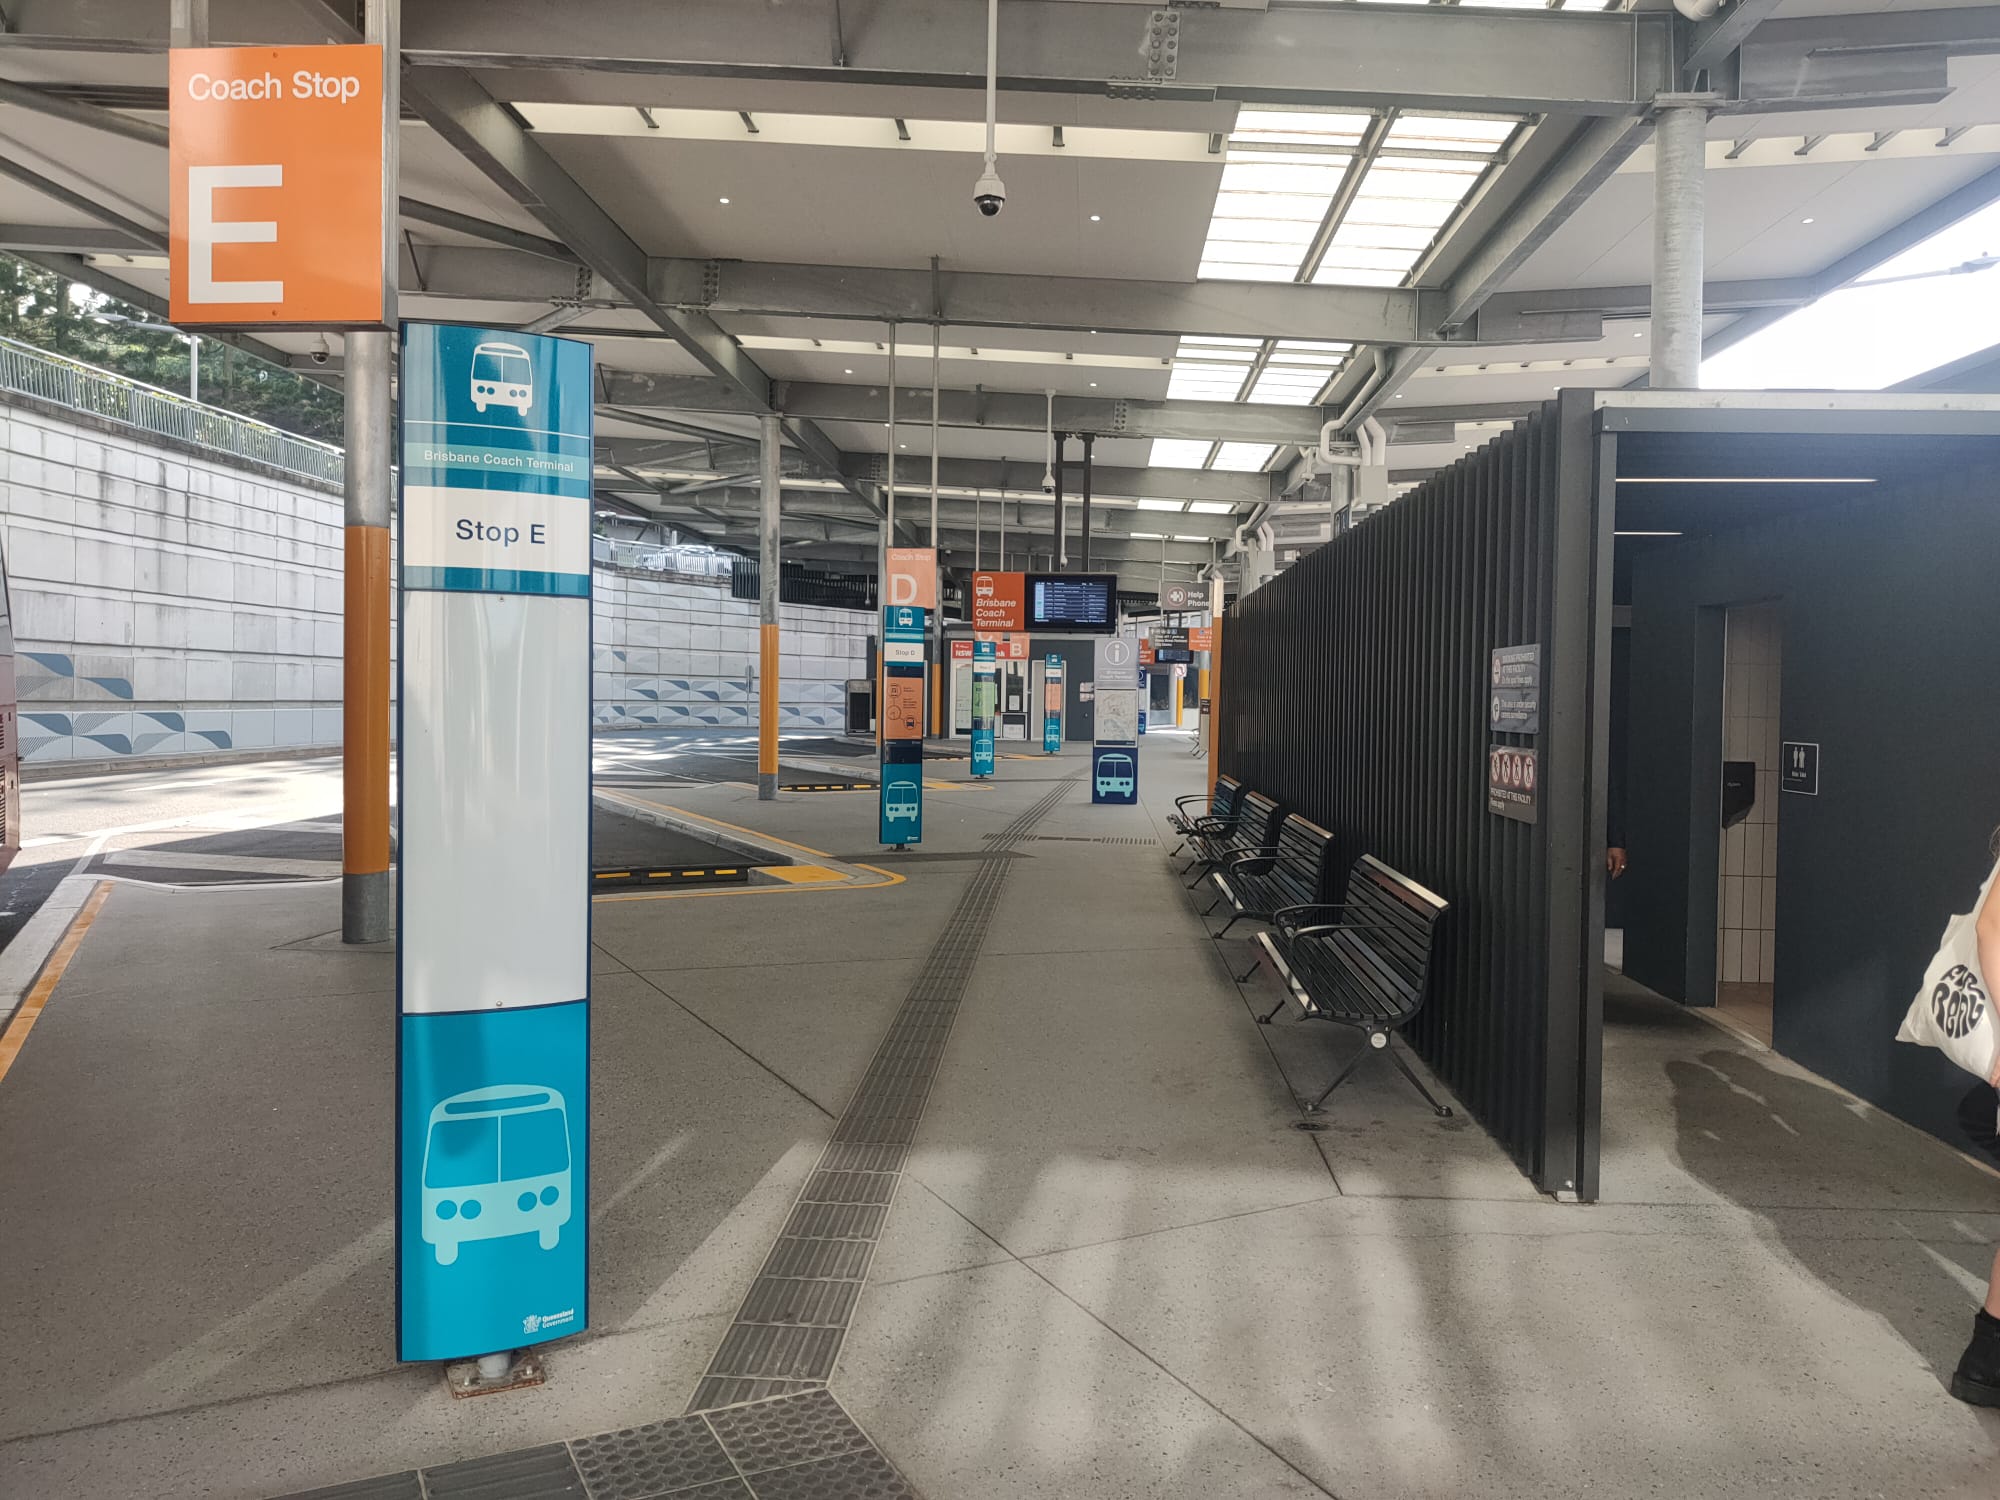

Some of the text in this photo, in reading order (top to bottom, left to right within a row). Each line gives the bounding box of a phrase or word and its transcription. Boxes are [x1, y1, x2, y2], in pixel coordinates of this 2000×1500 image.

[188, 70, 360, 104] Coach Stop
[188, 164, 284, 304] E
[424, 450, 574, 473] Brisbane Coach Terminal
[456, 519, 546, 547] Stop E
[891, 573, 918, 605] D
[1187, 591, 1204, 599] Help
[976, 598, 1017, 607] Brisbane
[975, 608, 1005, 617] Coach
[976, 618, 1014, 627] Terminal
[1011, 643, 1022, 656] B
